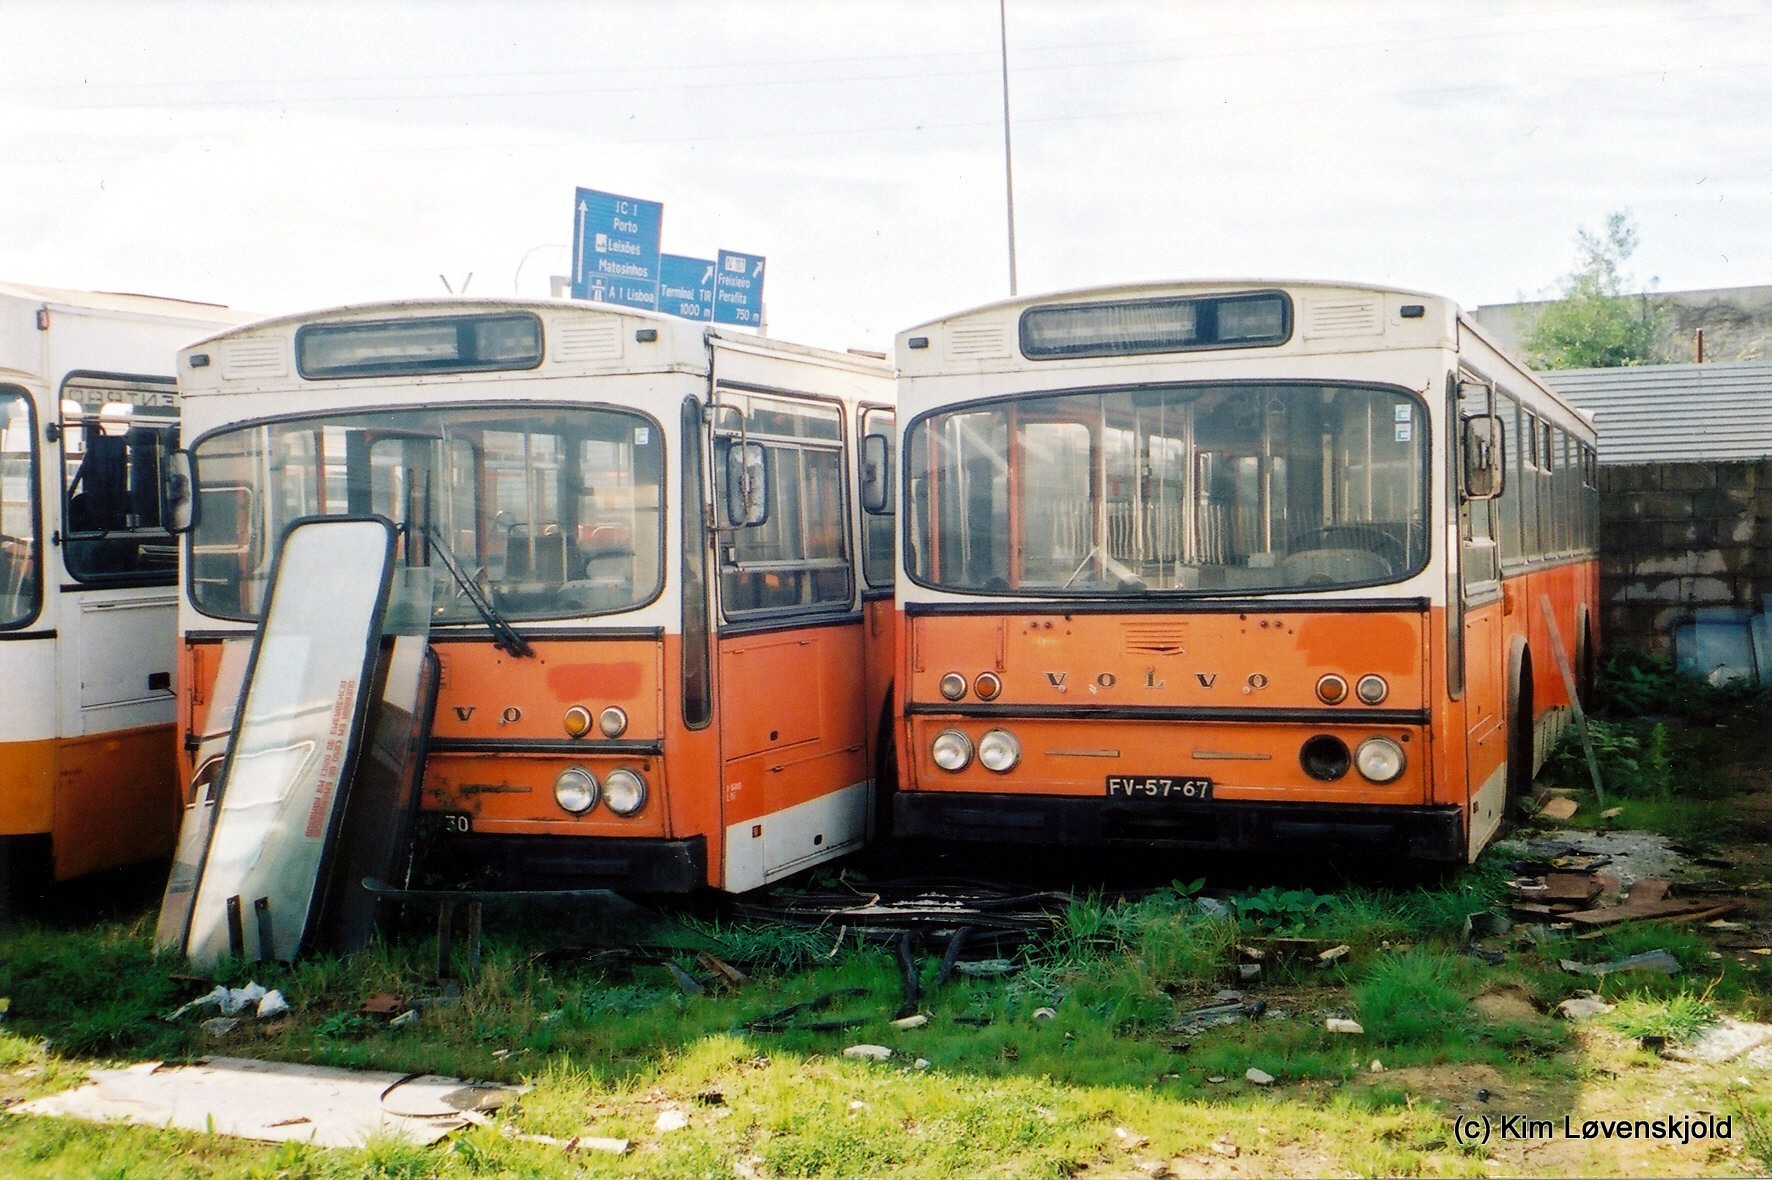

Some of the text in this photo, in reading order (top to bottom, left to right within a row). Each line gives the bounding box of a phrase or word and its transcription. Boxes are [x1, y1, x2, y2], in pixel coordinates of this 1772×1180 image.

[613, 216, 638, 234] Porto
[598, 258, 649, 278] Matosinhos
[608, 285, 616, 299] A
[627, 287, 655, 304] Lisboa
[660, 284, 713, 302] Terminal TIR
[718, 289, 748, 305] Perafita
[680, 303, 711, 317] 1000 m
[735, 308, 750, 321] 750
[1045, 671, 1270, 690] VOLVO
[1109, 778, 1209, 799] FV-57-67
